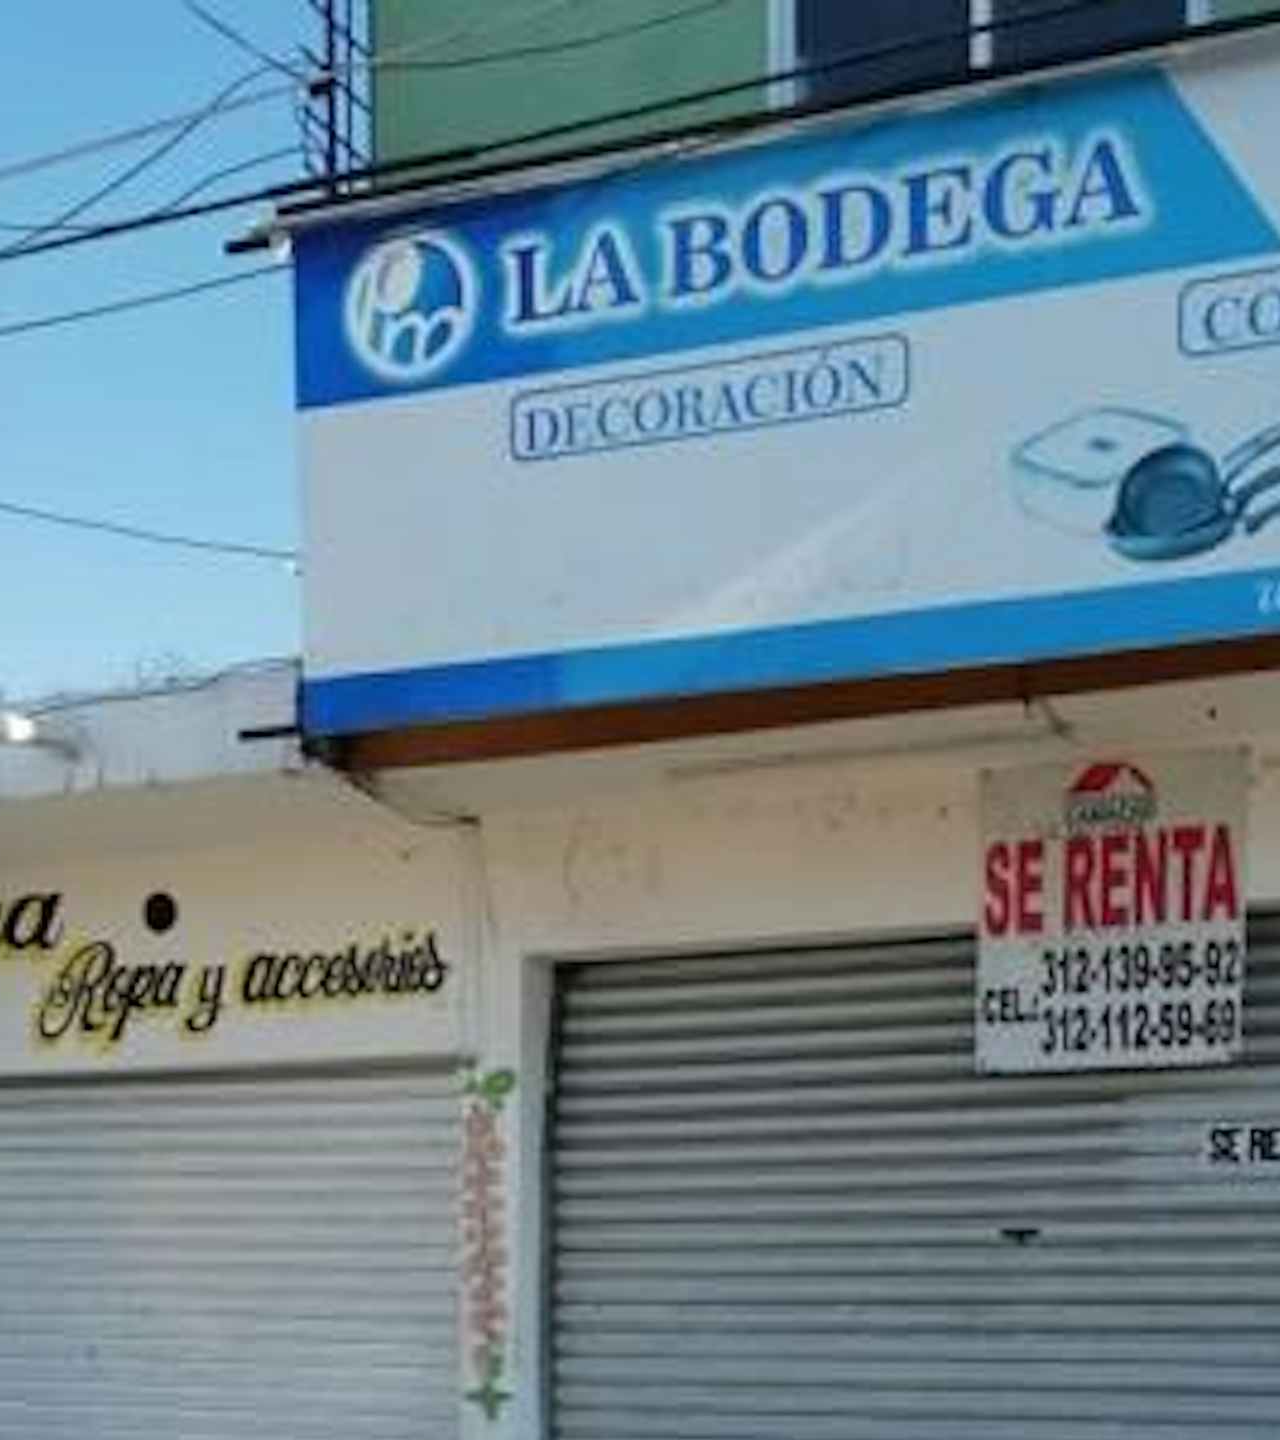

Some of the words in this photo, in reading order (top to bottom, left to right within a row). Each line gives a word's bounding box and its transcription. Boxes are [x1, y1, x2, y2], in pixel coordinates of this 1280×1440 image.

[508, 229, 640, 325] LA
[666, 136, 1144, 298] BODEGA
[523, 348, 886, 456] DECORACIÓN
[984, 838, 1042, 934] SE
[1062, 825, 1238, 930] RENTA
[40, 940, 188, 1042] Ropa
[186, 962, 226, 1032] y
[1041, 940, 1238, 998] 312-139-95-92
[1041, 1000, 1236, 1055] 312-112-59-69
[1210, 1128, 1241, 1164] SE
